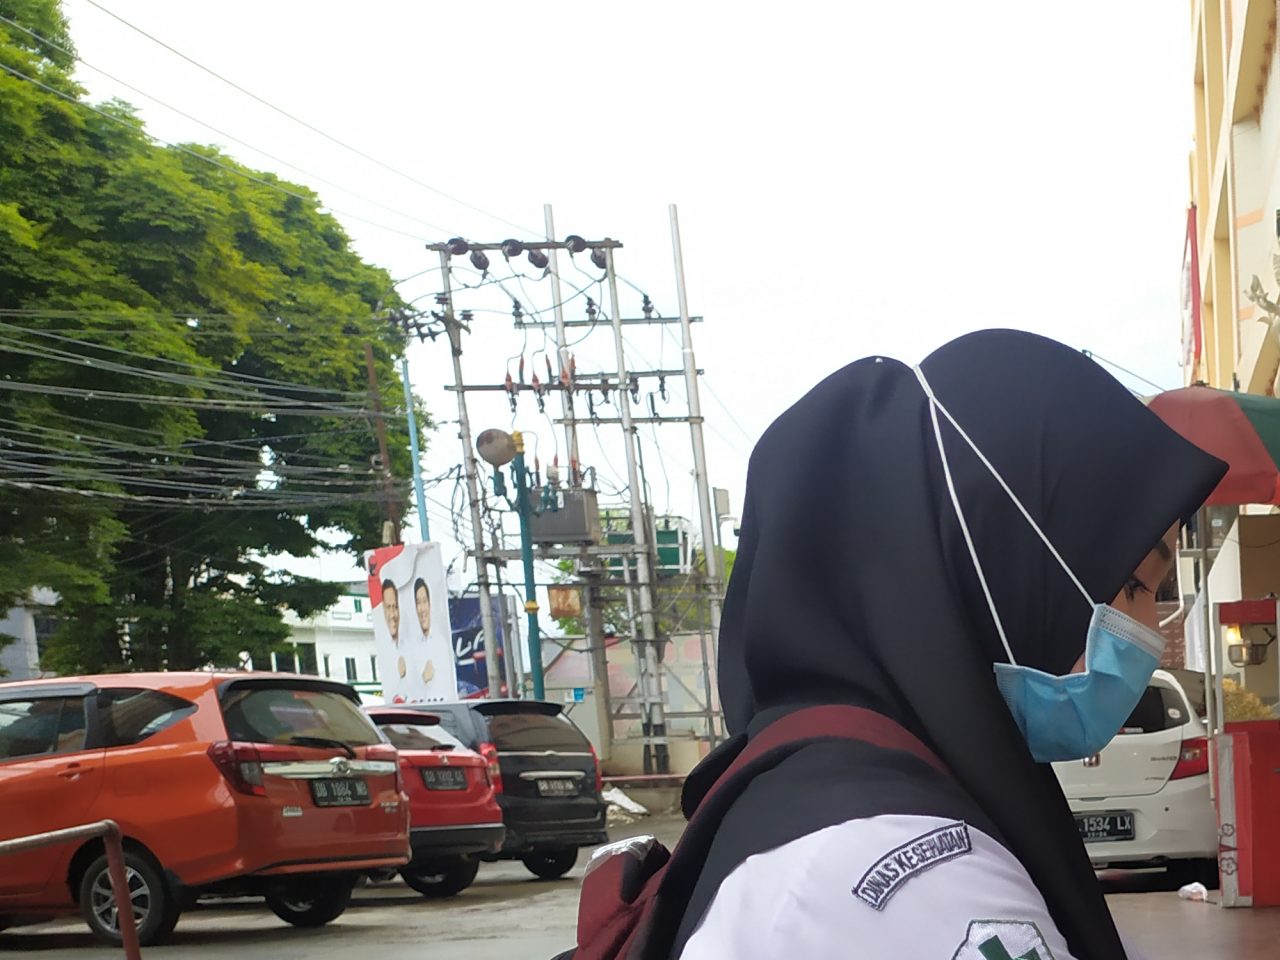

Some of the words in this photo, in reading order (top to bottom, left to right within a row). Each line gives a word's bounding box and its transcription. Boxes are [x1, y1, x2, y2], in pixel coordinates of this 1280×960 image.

[1083, 816, 1110, 832] 1534
[1116, 815, 1131, 830] LX
[861, 862, 900, 903] DINAS
